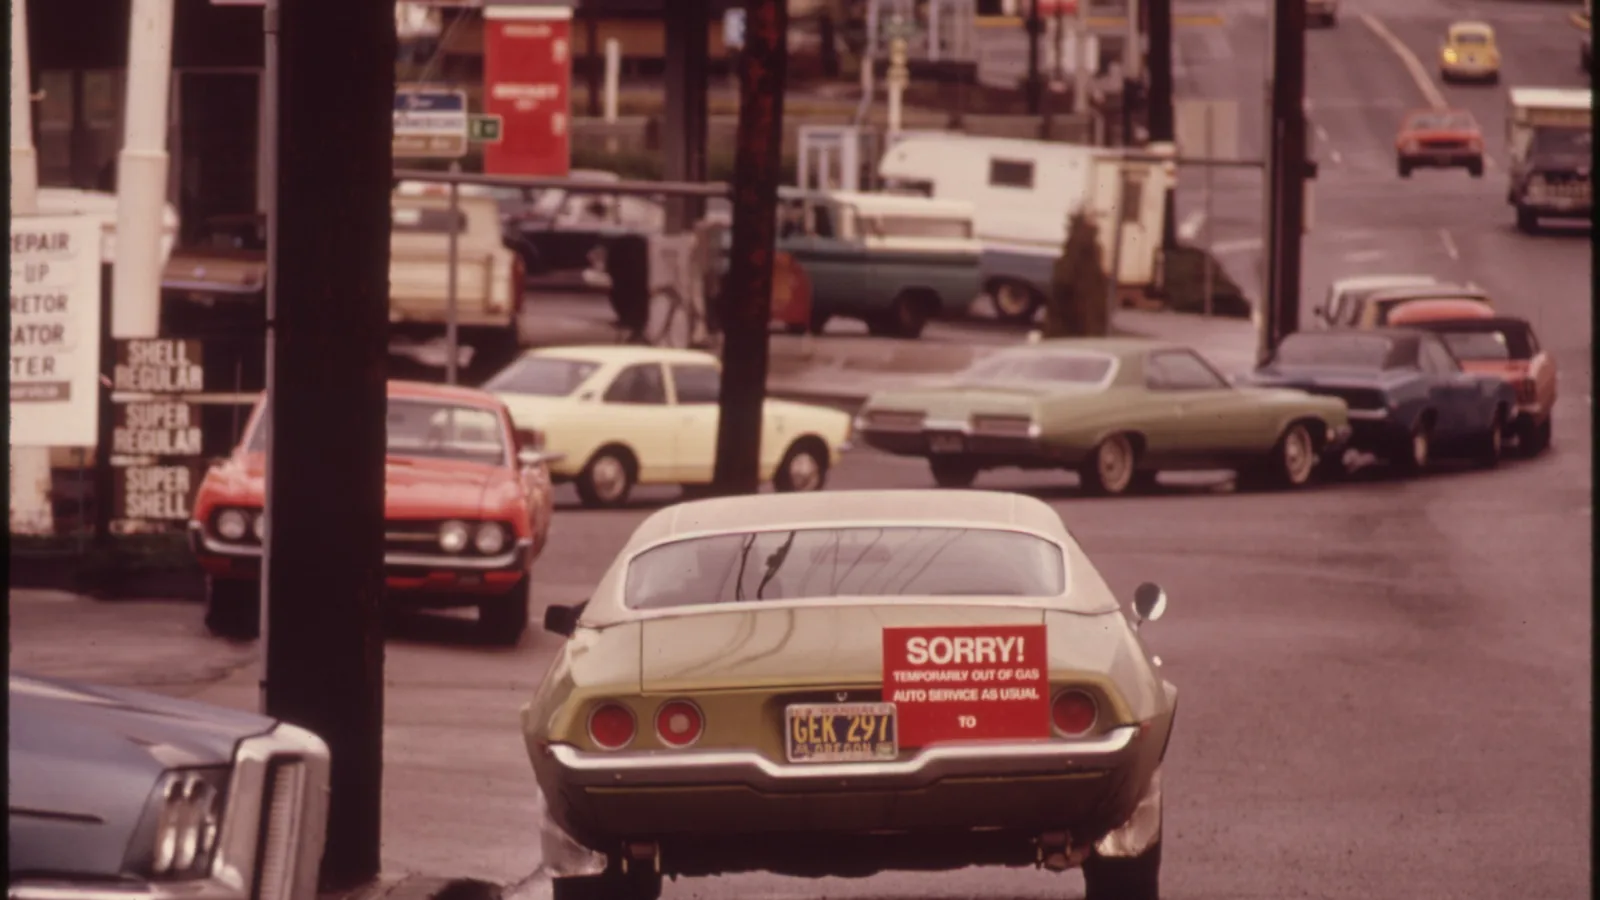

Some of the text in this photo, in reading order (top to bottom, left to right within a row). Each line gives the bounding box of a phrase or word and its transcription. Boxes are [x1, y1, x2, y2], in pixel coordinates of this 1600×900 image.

[128, 340, 190, 364] SHELL
[12, 356, 55, 375] TER
[114, 365, 203, 391] REGULAR
[126, 402, 190, 427] SUPER
[113, 427, 202, 454] REGULAR
[126, 466, 190, 493] SUPER
[126, 493, 190, 519] SHELL
[906, 637, 1025, 665] SORRY!
[893, 668, 1039, 682] TEMPORARILY OUT OF GAS
[893, 688, 926, 702] AUTO
[928, 688, 978, 702] SERVICE
[981, 687, 998, 700] AS
[793, 713, 888, 744] GEK 297
[957, 715, 977, 728] TO
